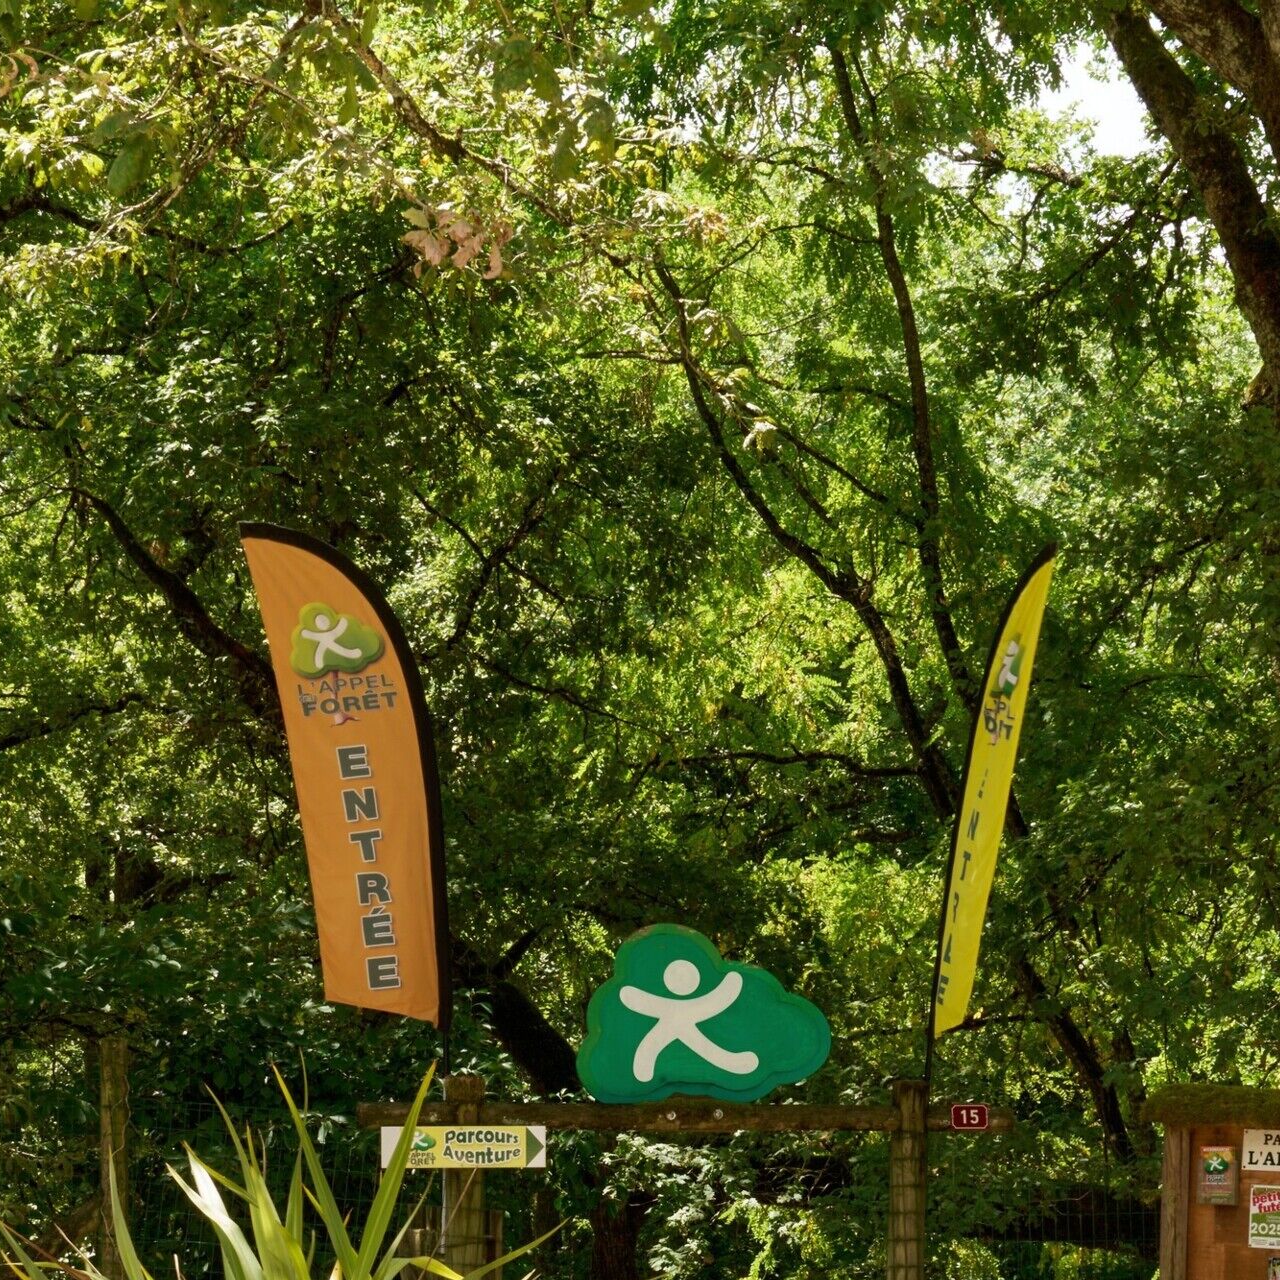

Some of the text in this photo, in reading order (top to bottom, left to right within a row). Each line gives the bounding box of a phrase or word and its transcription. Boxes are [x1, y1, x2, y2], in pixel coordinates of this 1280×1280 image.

[297, 674, 394, 697] L'APPEL
[302, 689, 398, 717] FORÊT
[335, 744, 401, 991] ENTRÉE
[960, 1109, 979, 1124] 15
[445, 1130, 518, 1144] Parcours
[443, 1145, 521, 1164] Aventure
